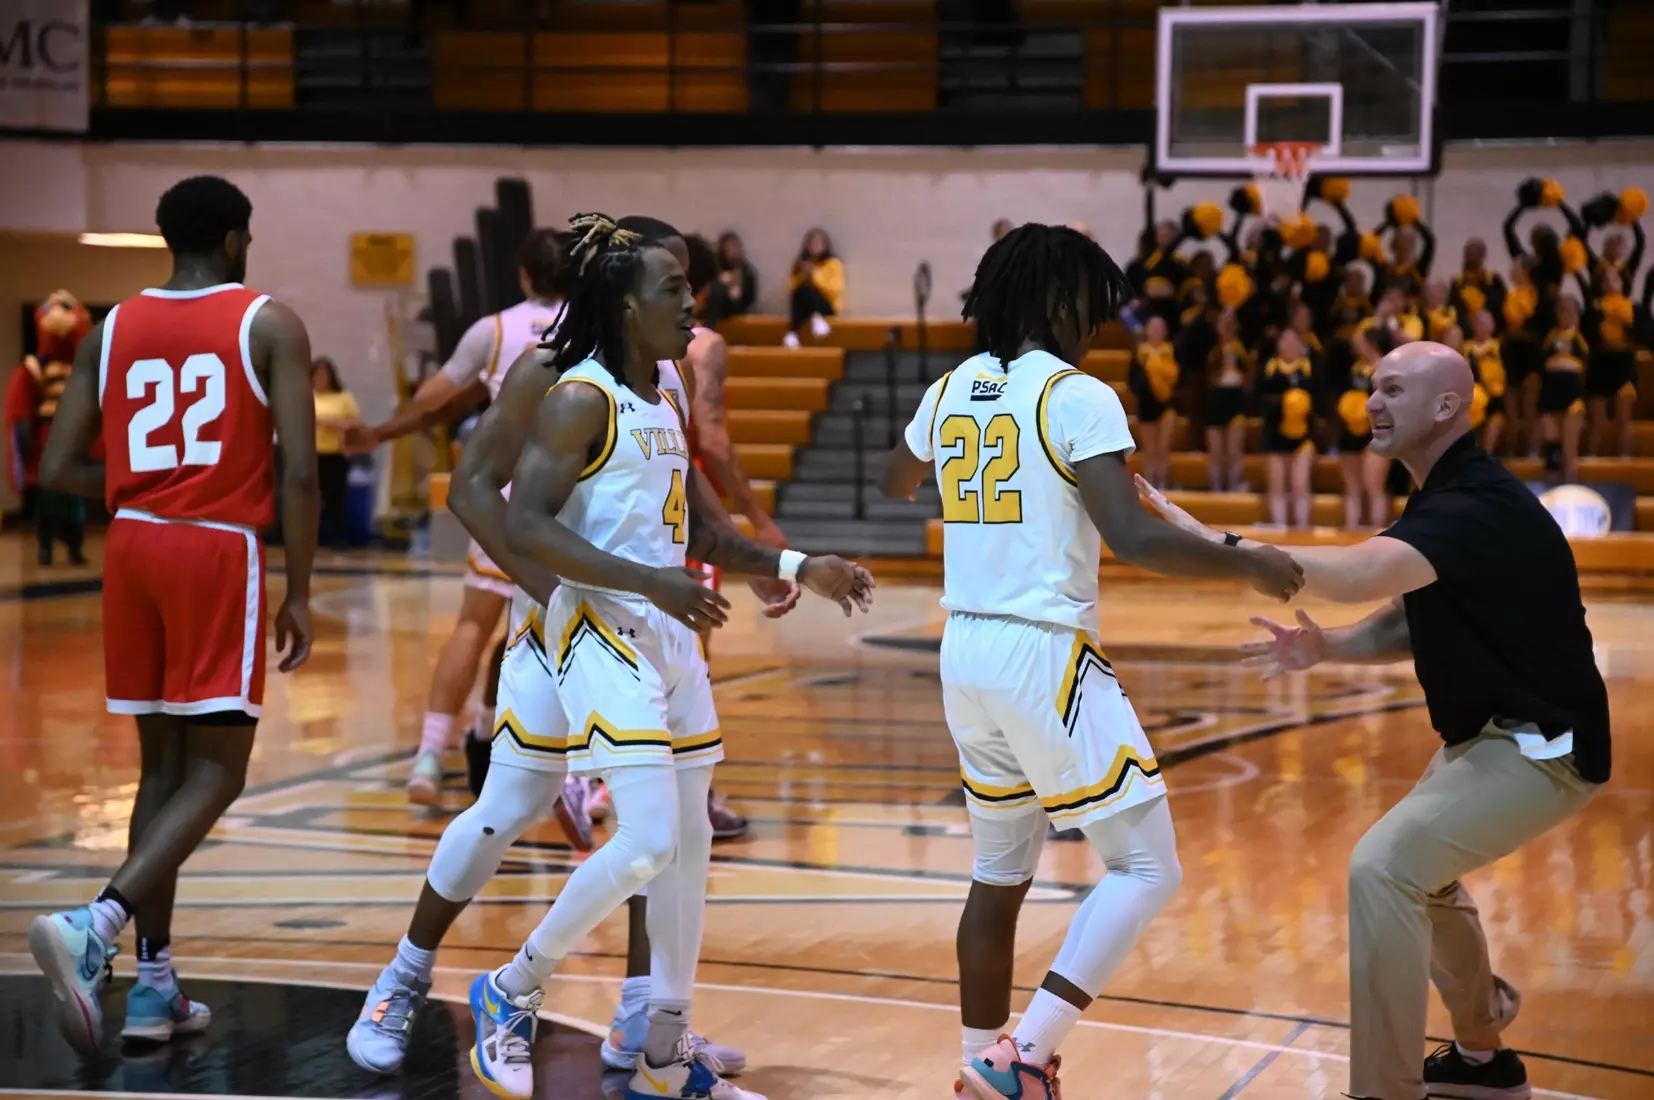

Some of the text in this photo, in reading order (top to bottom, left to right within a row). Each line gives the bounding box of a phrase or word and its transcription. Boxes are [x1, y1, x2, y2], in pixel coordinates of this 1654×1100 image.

[126, 352, 226, 473] 22
[971, 380, 1008, 394] PSAC
[662, 469, 686, 544] 4
[940, 413, 1023, 524] 22
